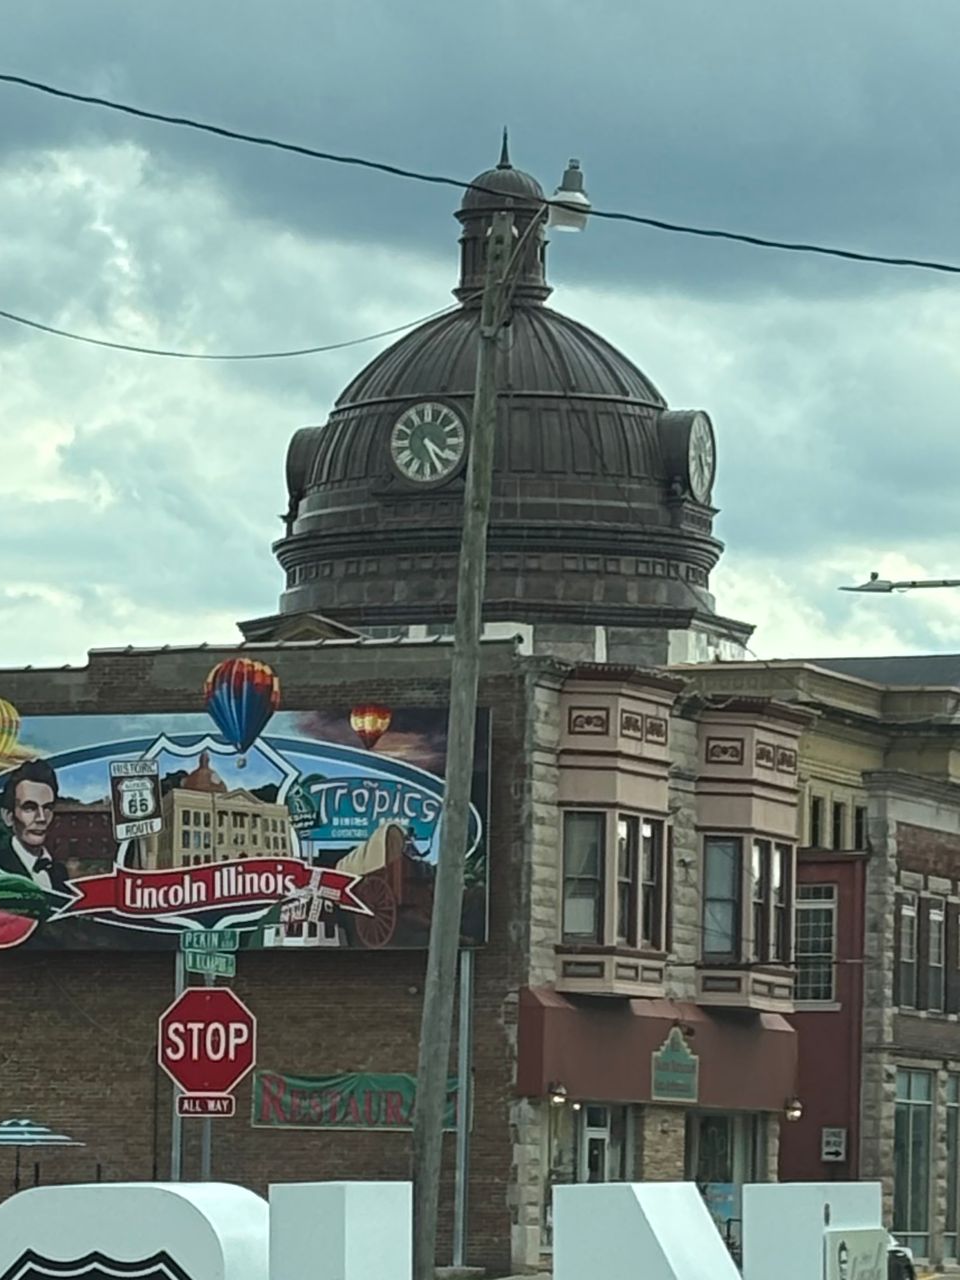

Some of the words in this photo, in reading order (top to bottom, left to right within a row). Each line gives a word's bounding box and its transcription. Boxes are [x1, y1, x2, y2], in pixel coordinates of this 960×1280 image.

[128, 799, 148, 814] 66
[310, 781, 440, 824] Tropics
[125, 820, 155, 836] ROUTE
[124, 875, 206, 909] Lincoln
[214, 864, 296, 899] Illinois
[185, 932, 219, 948] PEKIN
[165, 1022, 249, 1061] STOP
[182, 1099, 202, 1112] ALL
[207, 1099, 229, 1112] WAY
[260, 1074, 458, 1124] RESTAUR
